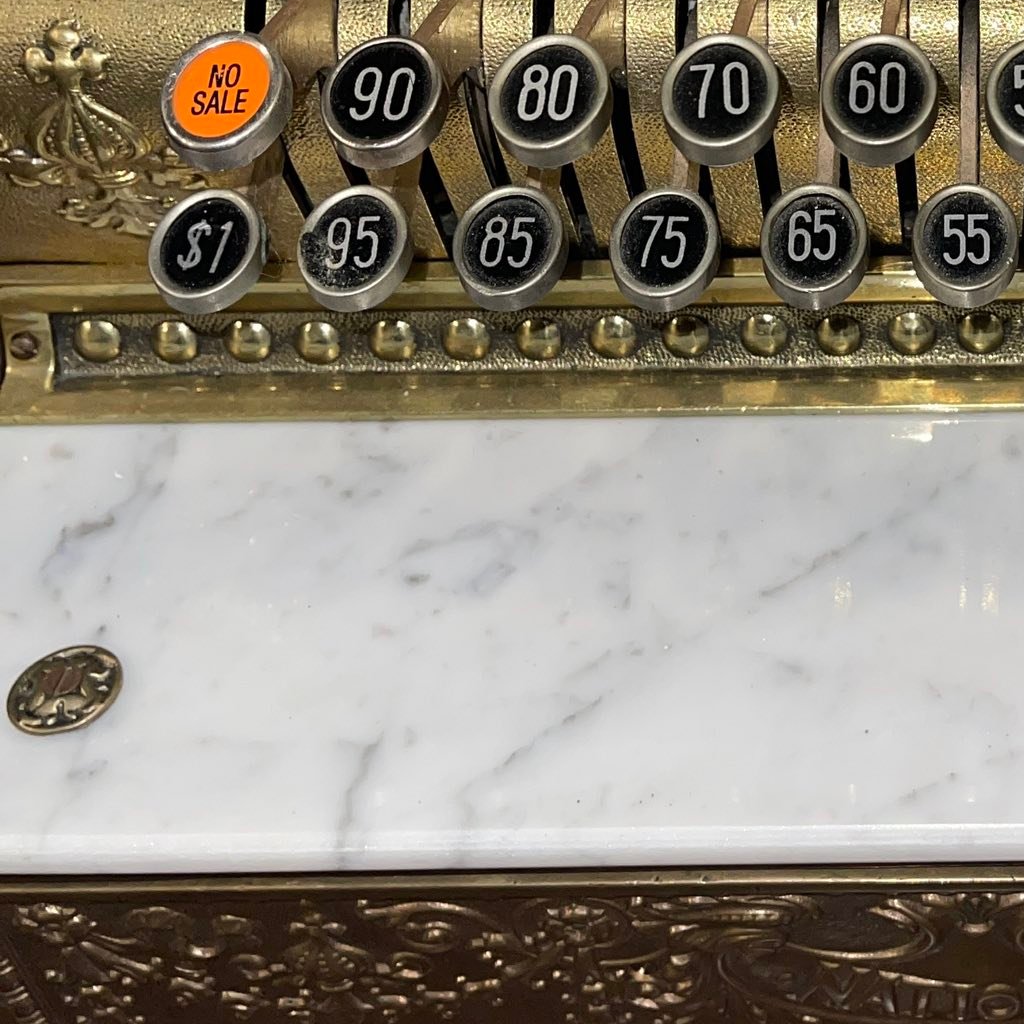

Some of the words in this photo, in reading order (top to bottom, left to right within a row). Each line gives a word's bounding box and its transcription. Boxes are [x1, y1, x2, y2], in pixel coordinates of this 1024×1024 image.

[208, 63, 241, 89] NO
[350, 67, 415, 121] 90
[518, 65, 578, 121] 80
[690, 62, 749, 118] 70
[850, 62, 905, 114] 60
[190, 88, 247, 117] SALE
[178, 220, 232, 272] $1
[324, 216, 380, 269] 95
[480, 215, 535, 267] 85
[641, 216, 688, 268] 75
[788, 209, 836, 261] 65
[944, 214, 990, 265] 55
